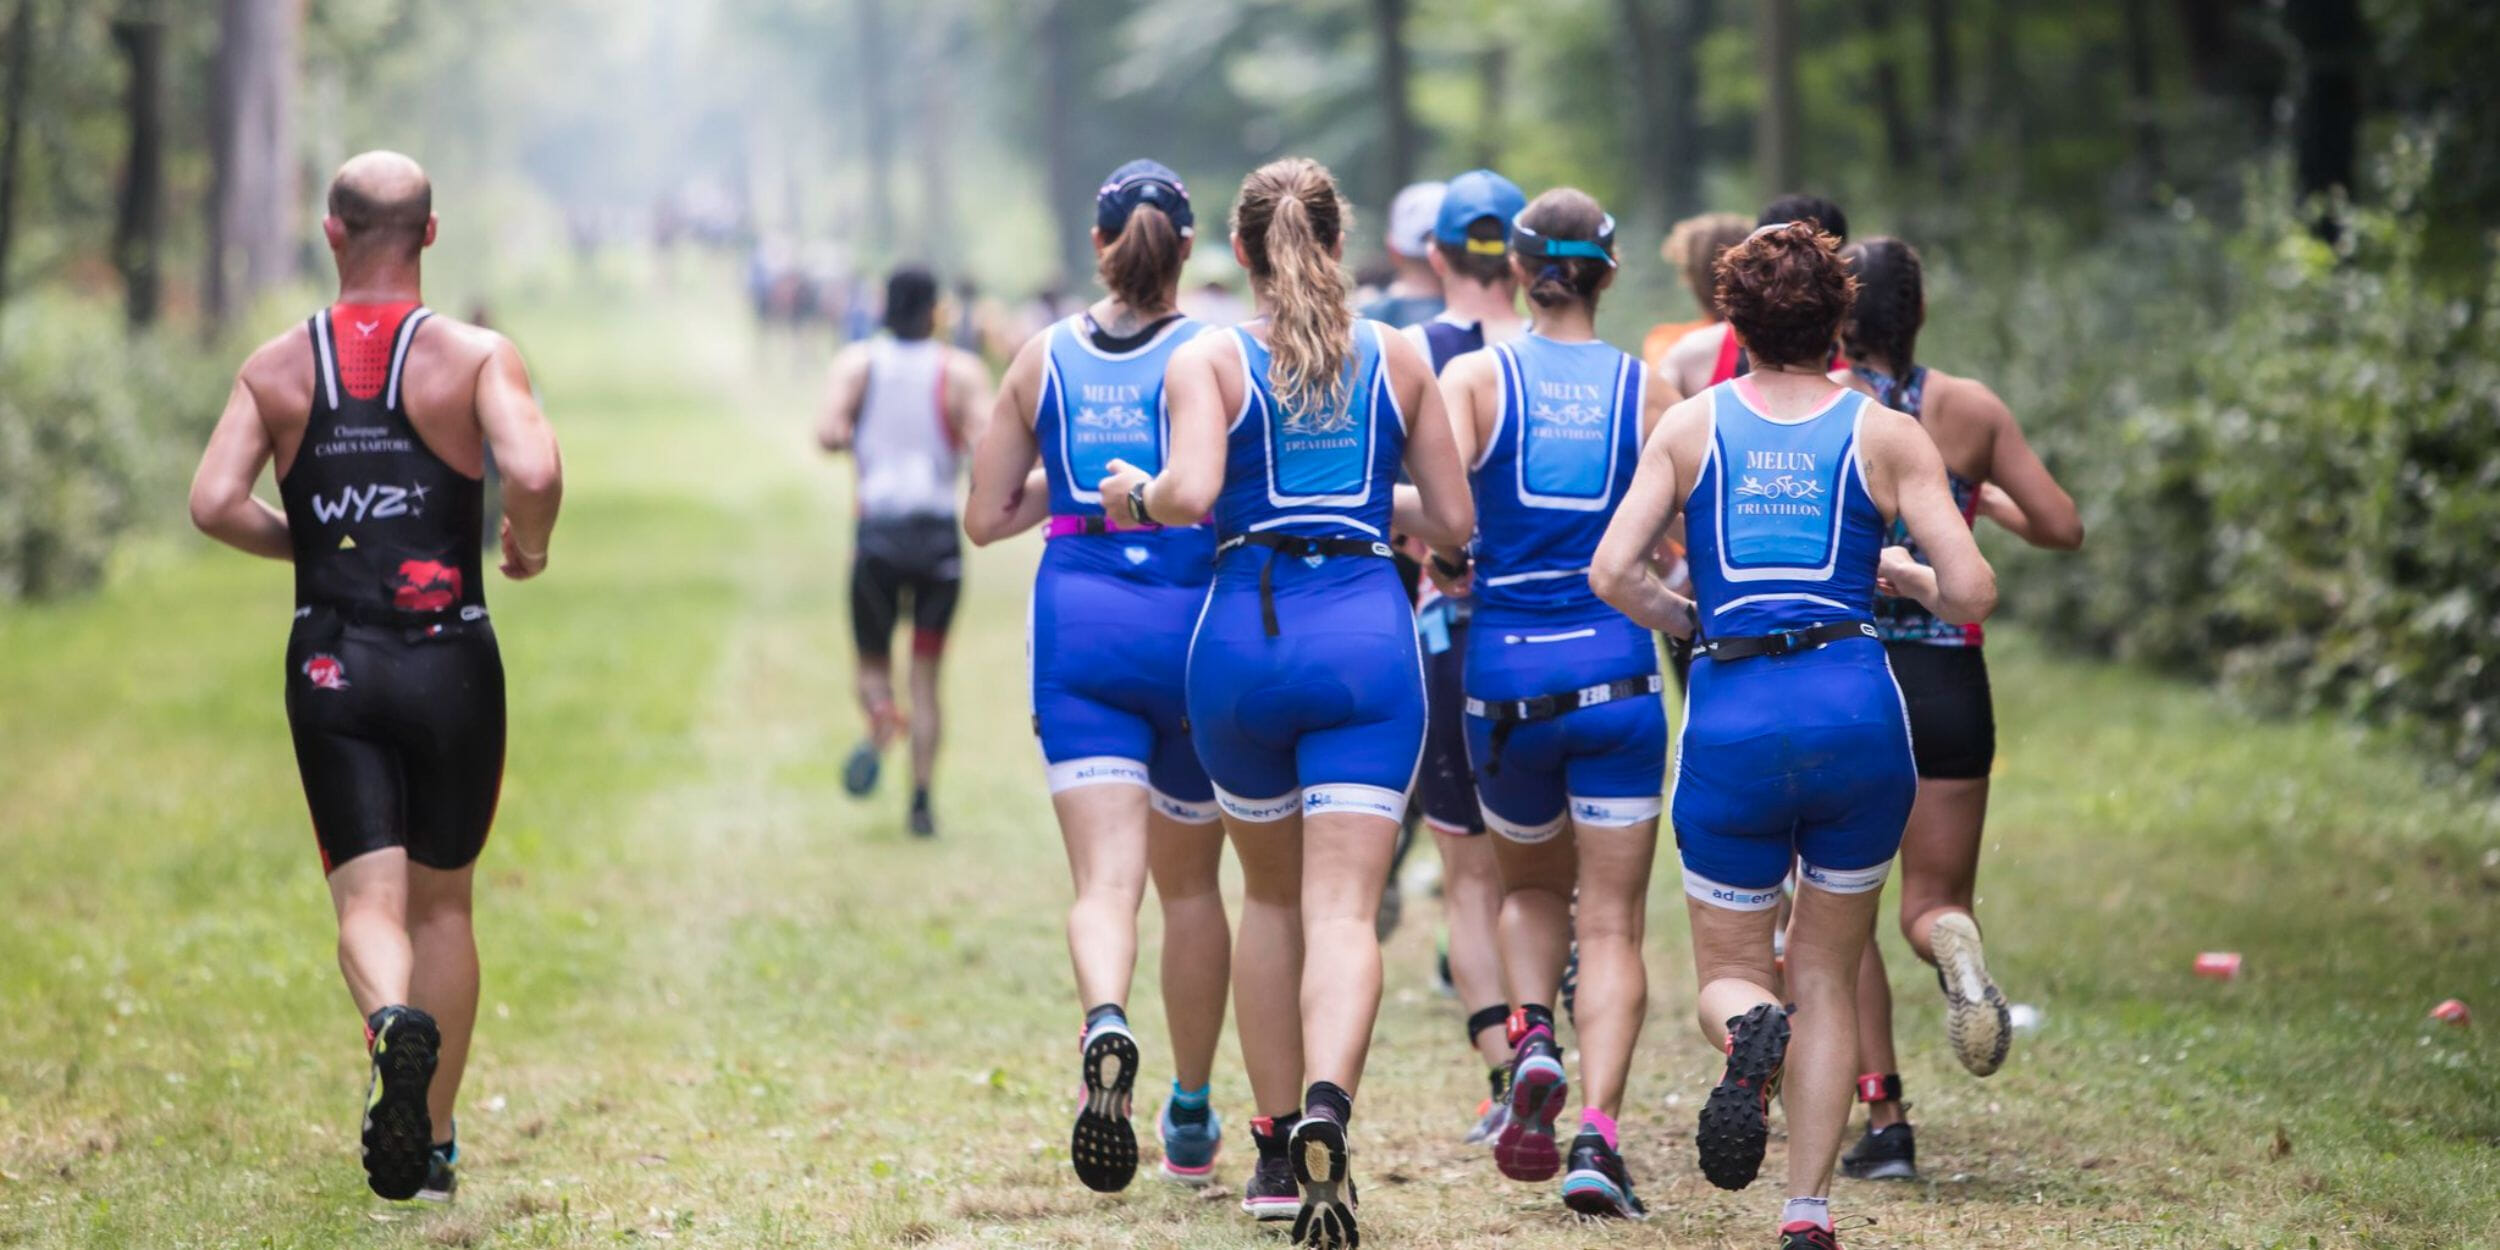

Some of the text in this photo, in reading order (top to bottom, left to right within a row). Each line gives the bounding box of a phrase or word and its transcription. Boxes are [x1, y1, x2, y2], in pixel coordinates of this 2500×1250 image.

[1082, 384, 1141, 402] MELUN
[1539, 381, 1599, 400] MELUN
[1285, 437, 1357, 452] TRIATHLON
[1746, 450, 1816, 471] MELUN
[1736, 503, 1821, 516] TRIATHLON
